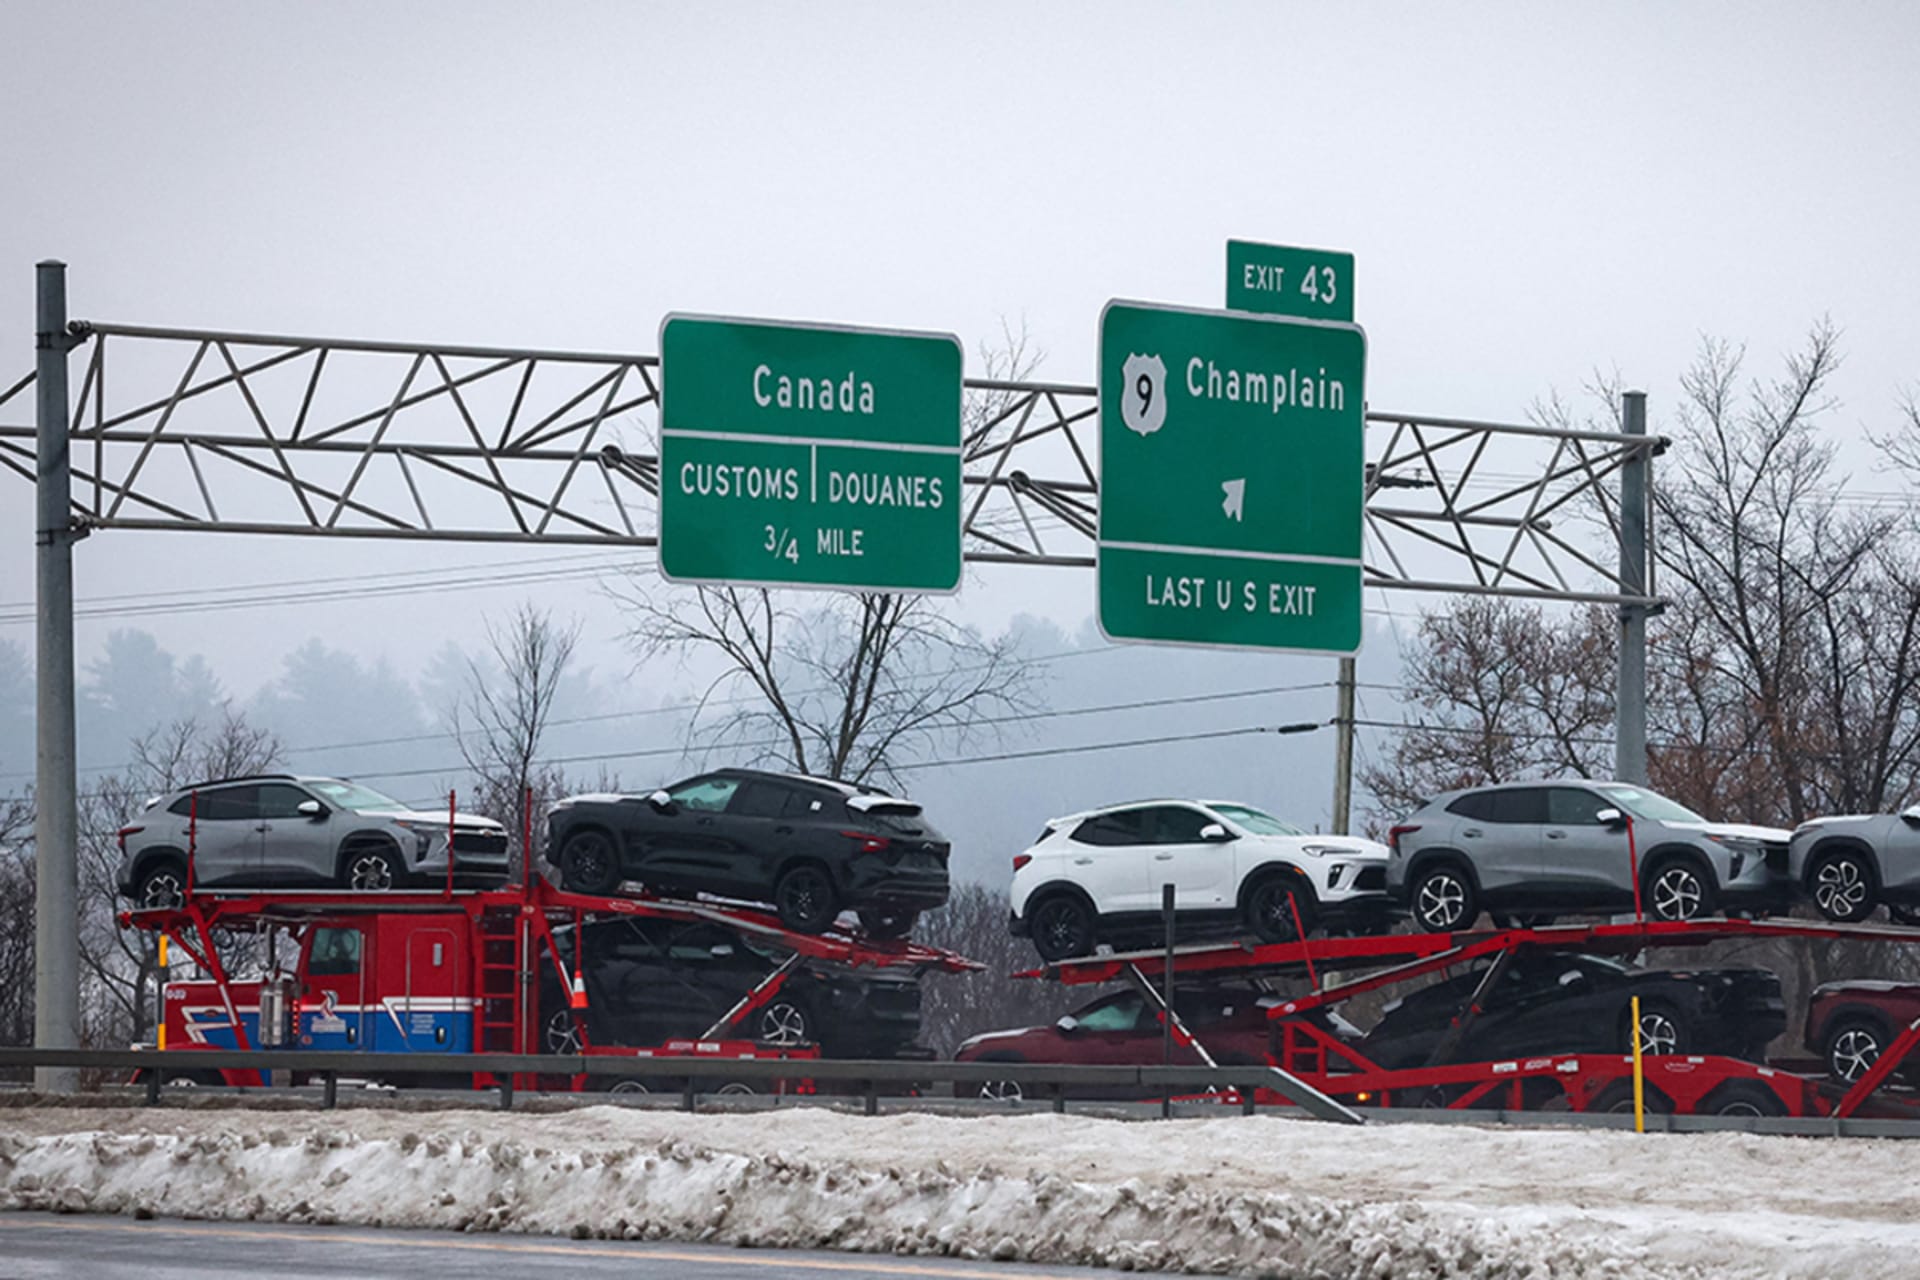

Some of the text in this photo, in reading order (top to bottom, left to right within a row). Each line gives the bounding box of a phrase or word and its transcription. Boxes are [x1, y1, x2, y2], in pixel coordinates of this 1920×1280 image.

[1244, 264, 1336, 304] EXIT 43
[753, 364, 874, 414] Canada
[1136, 373, 1153, 418] 9
[1186, 357, 1344, 414] Champlain
[681, 462, 799, 500] CUSTOMS
[829, 471, 943, 509] DOUANES
[764, 524, 864, 564] 3/4 MILE
[1147, 575, 1316, 616] LAST U S EXIT
